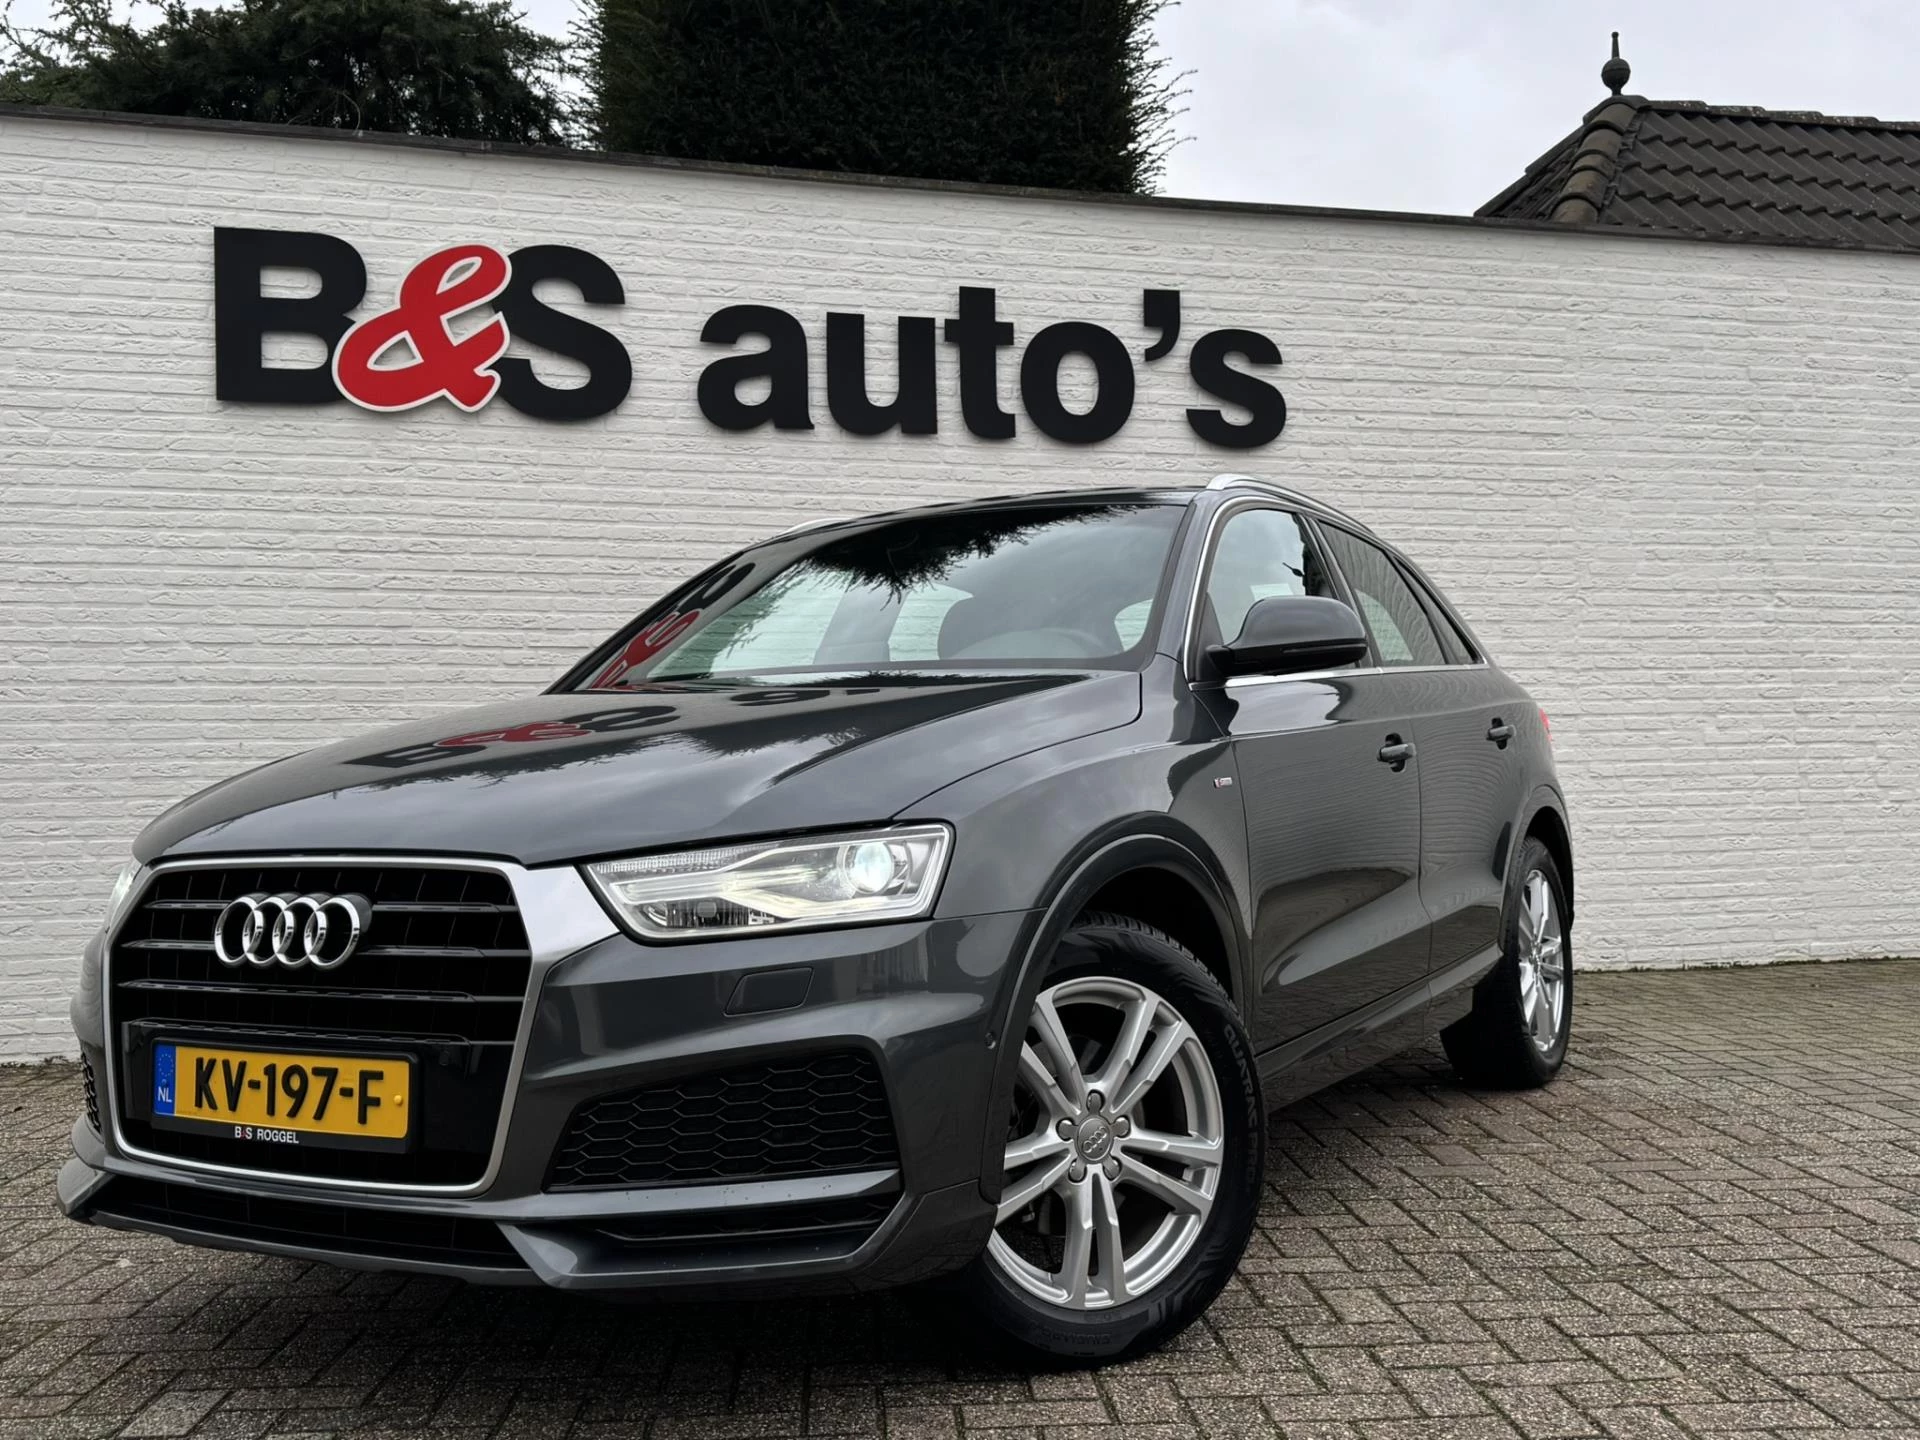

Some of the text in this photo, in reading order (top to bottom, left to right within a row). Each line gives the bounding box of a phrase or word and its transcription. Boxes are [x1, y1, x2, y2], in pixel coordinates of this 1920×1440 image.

[214, 227, 1287, 452] B&S auto's
[158, 1086, 172, 1103] NL
[194, 1057, 384, 1125] KV-197-F
[1223, 1023, 1258, 1128] QUATRAC
[257, 1128, 299, 1144] ROGGEL
